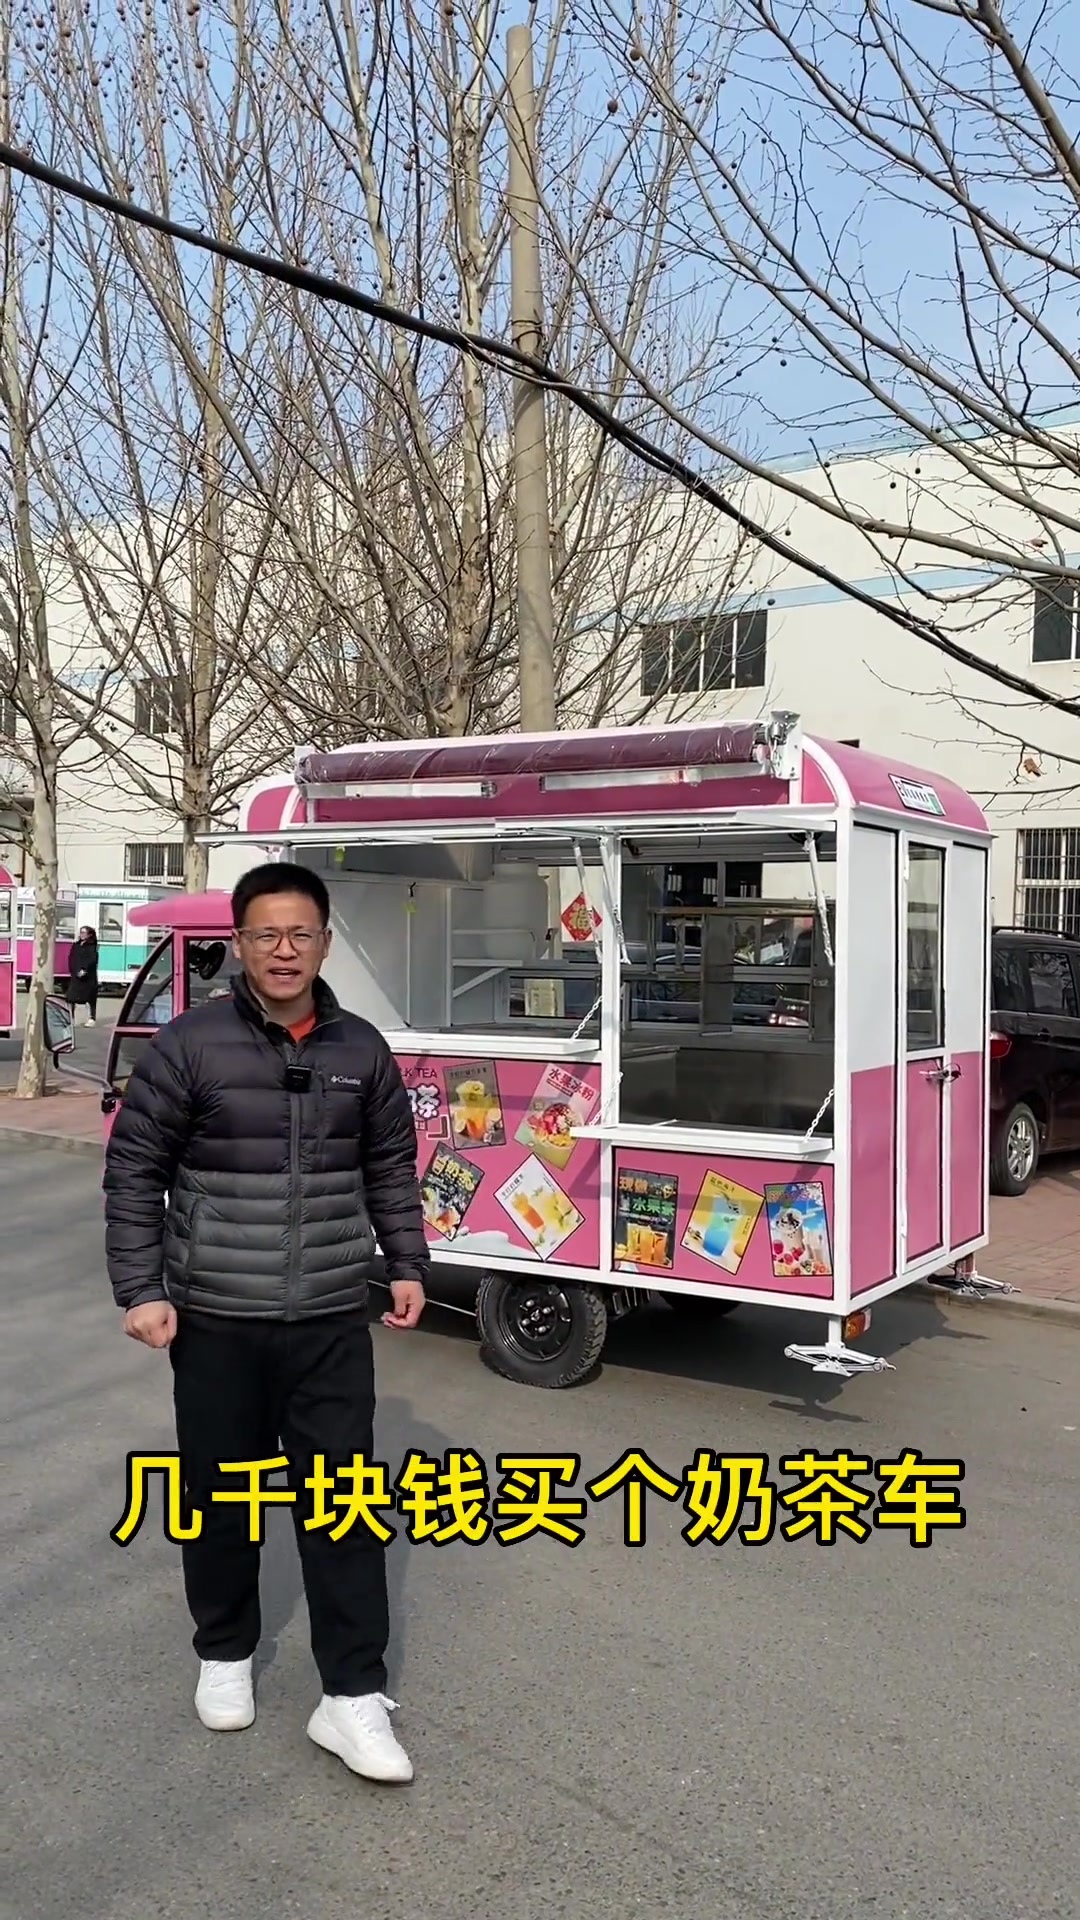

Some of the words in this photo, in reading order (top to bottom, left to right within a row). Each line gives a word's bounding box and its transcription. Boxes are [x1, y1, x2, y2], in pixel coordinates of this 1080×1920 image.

[415, 1068, 437, 1078] TEA
[548, 1068, 595, 1101] 水果冰粉
